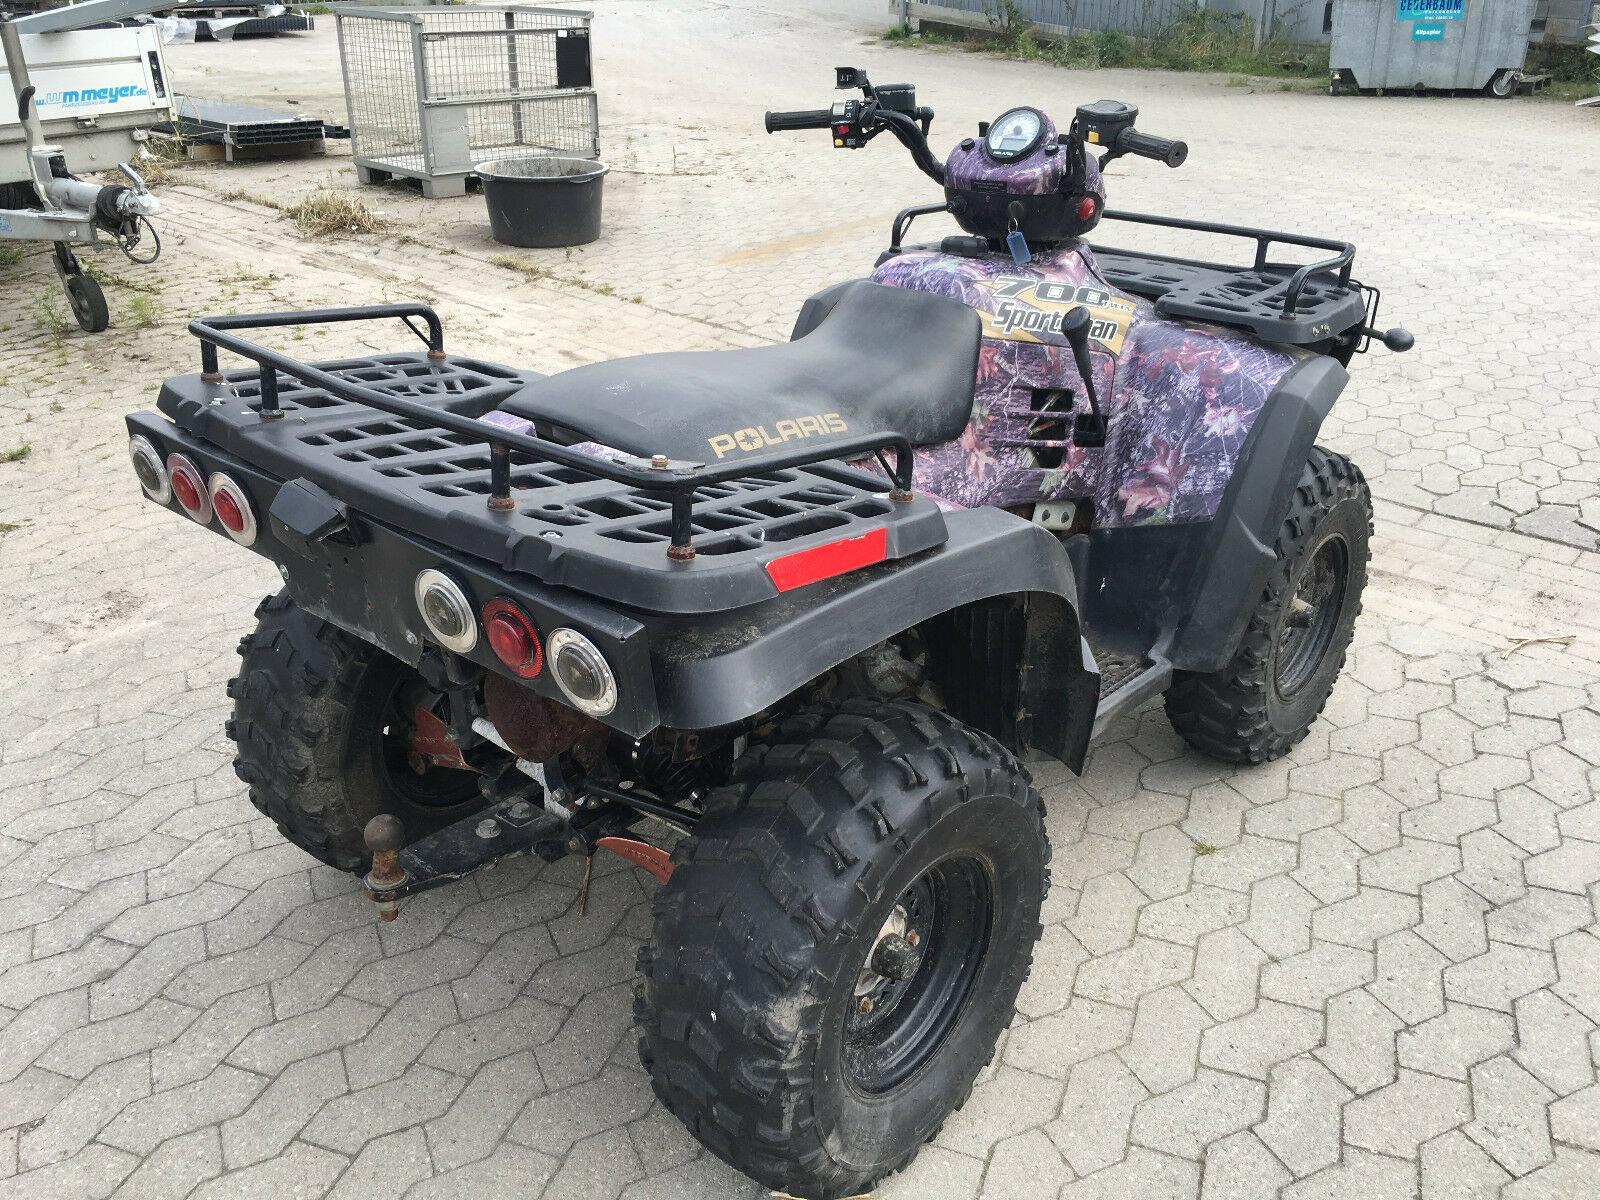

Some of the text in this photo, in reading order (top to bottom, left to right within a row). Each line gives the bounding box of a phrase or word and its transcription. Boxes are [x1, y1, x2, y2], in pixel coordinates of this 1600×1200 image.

[991, 275, 1110, 307] 700
[991, 301, 1119, 341] Sportan
[708, 412, 848, 459] POLARIS
